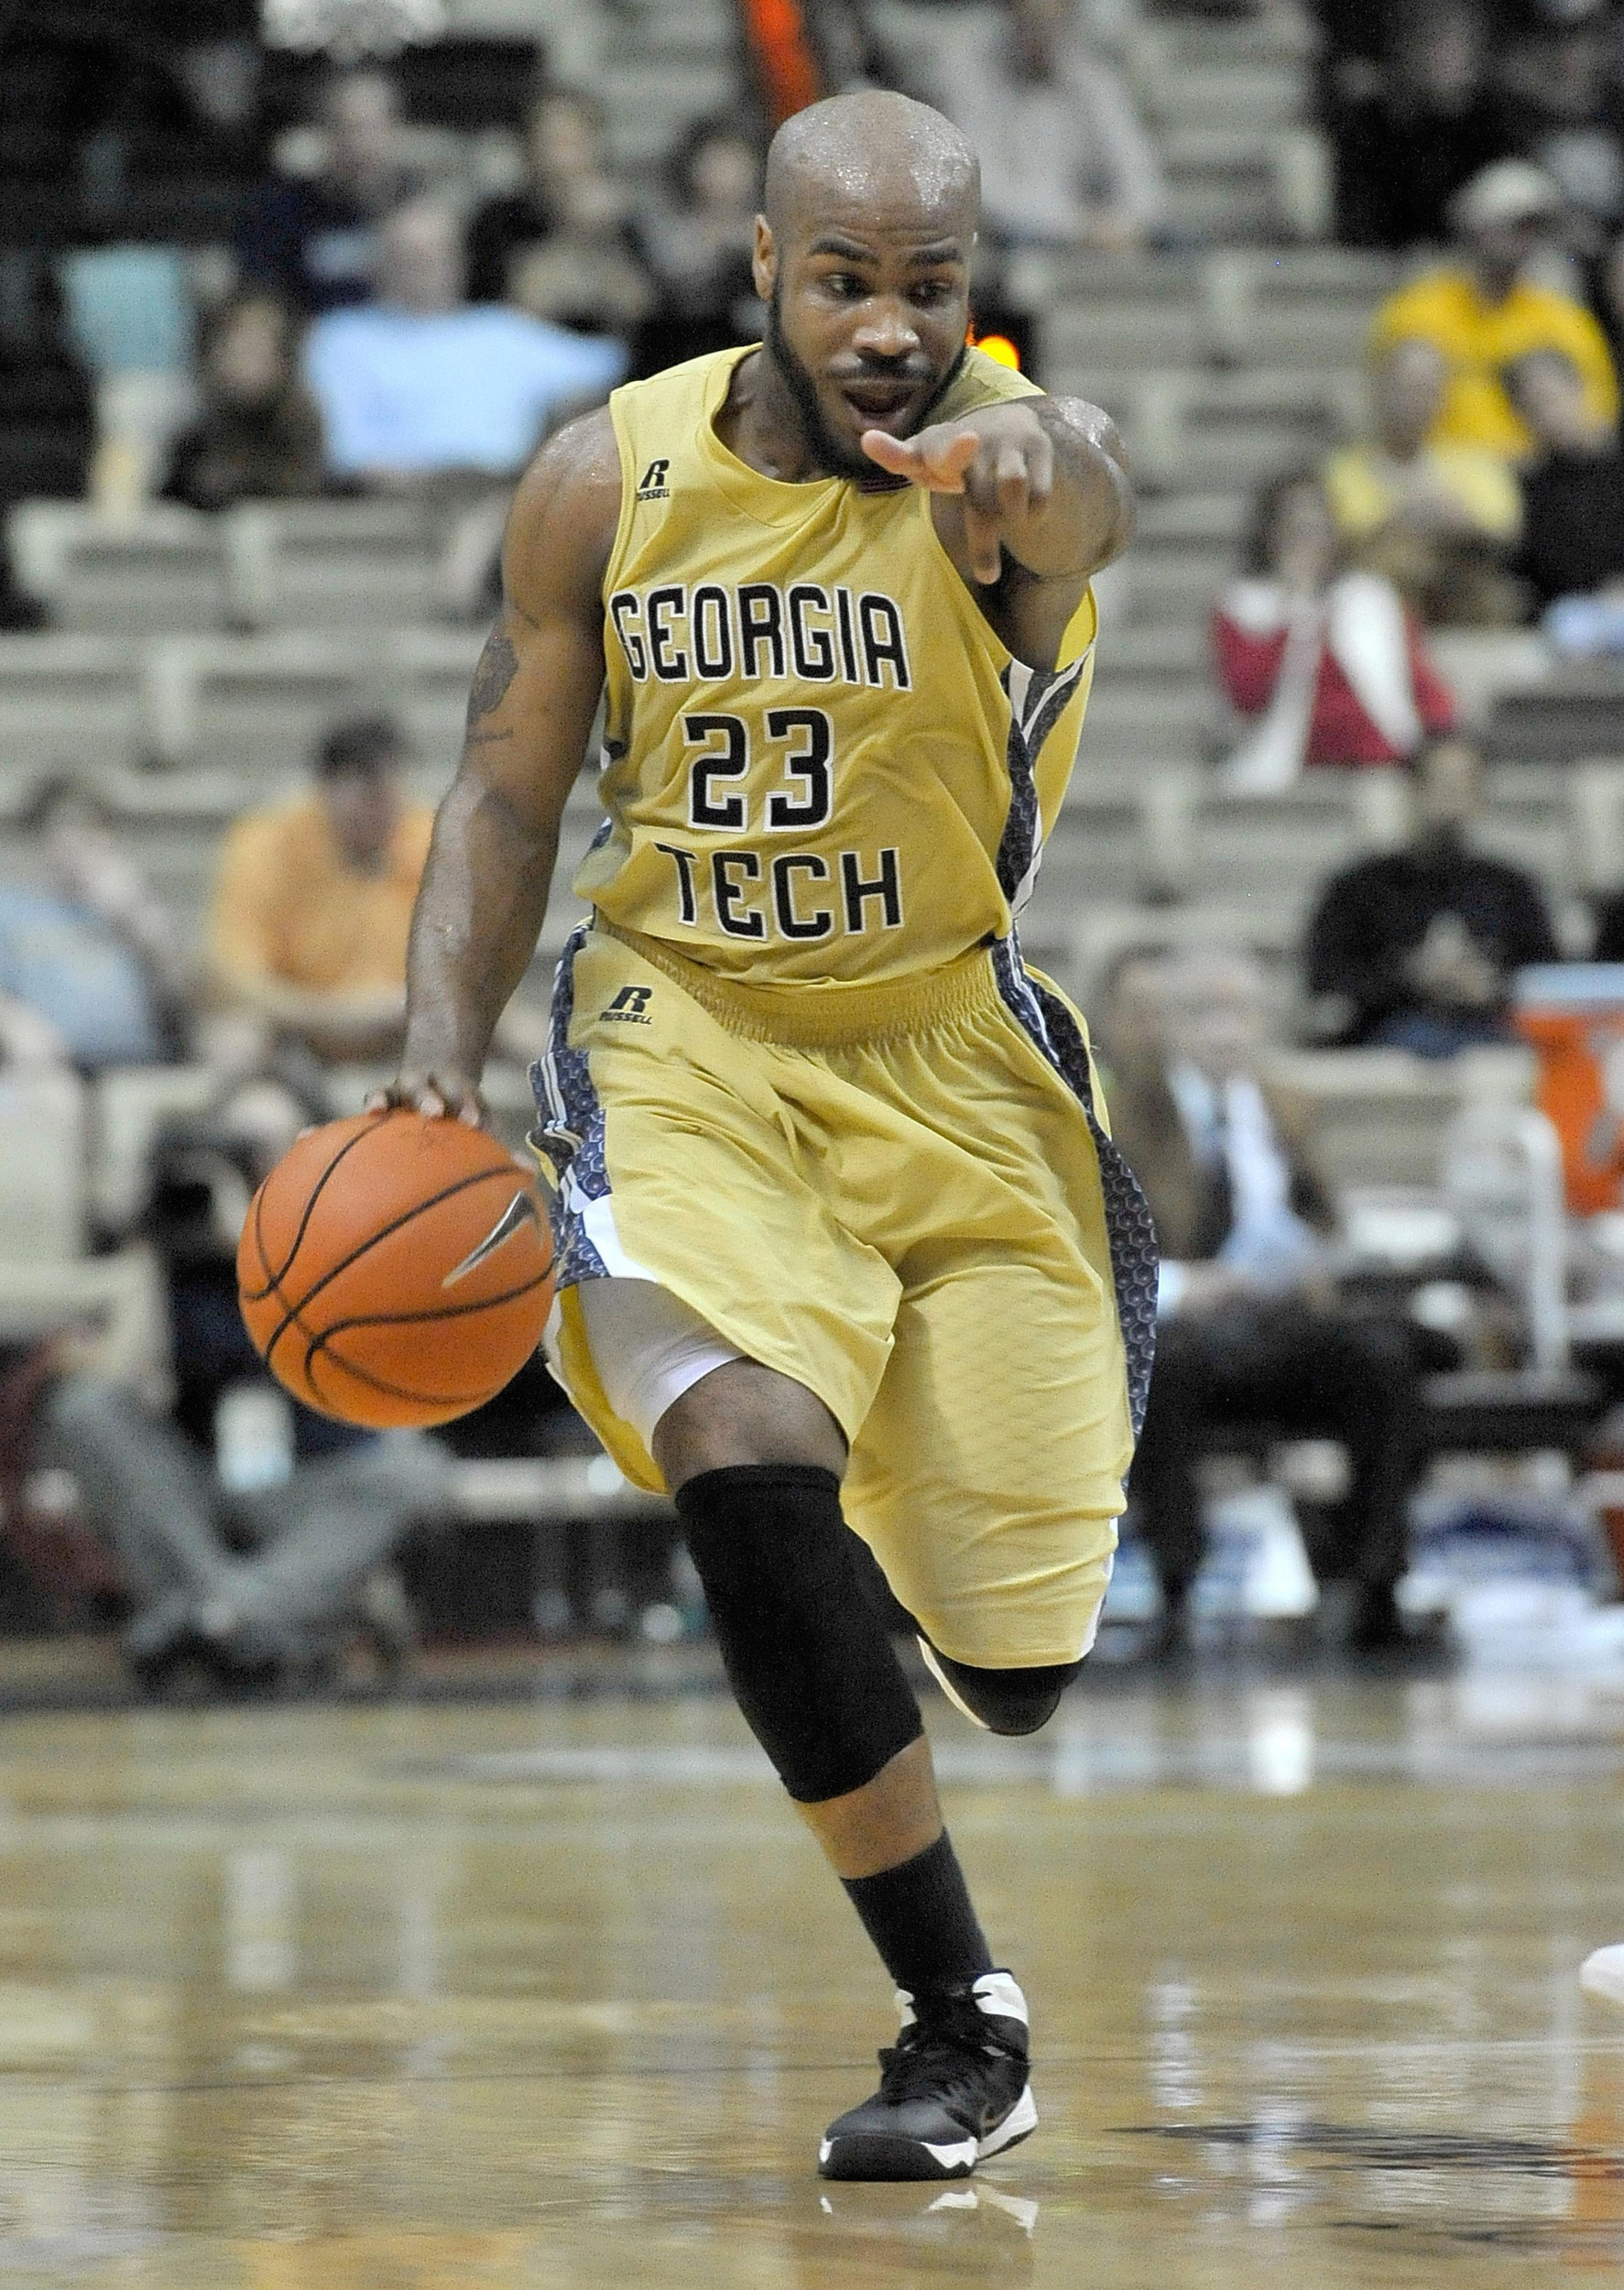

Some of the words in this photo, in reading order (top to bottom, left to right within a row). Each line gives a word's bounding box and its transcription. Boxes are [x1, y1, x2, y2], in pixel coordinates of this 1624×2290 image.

[639, 459, 670, 489] R
[609, 583, 912, 692] GEORGIA
[680, 706, 835, 834] 23
[654, 841, 905, 942] TECH
[608, 987, 652, 1013] R
